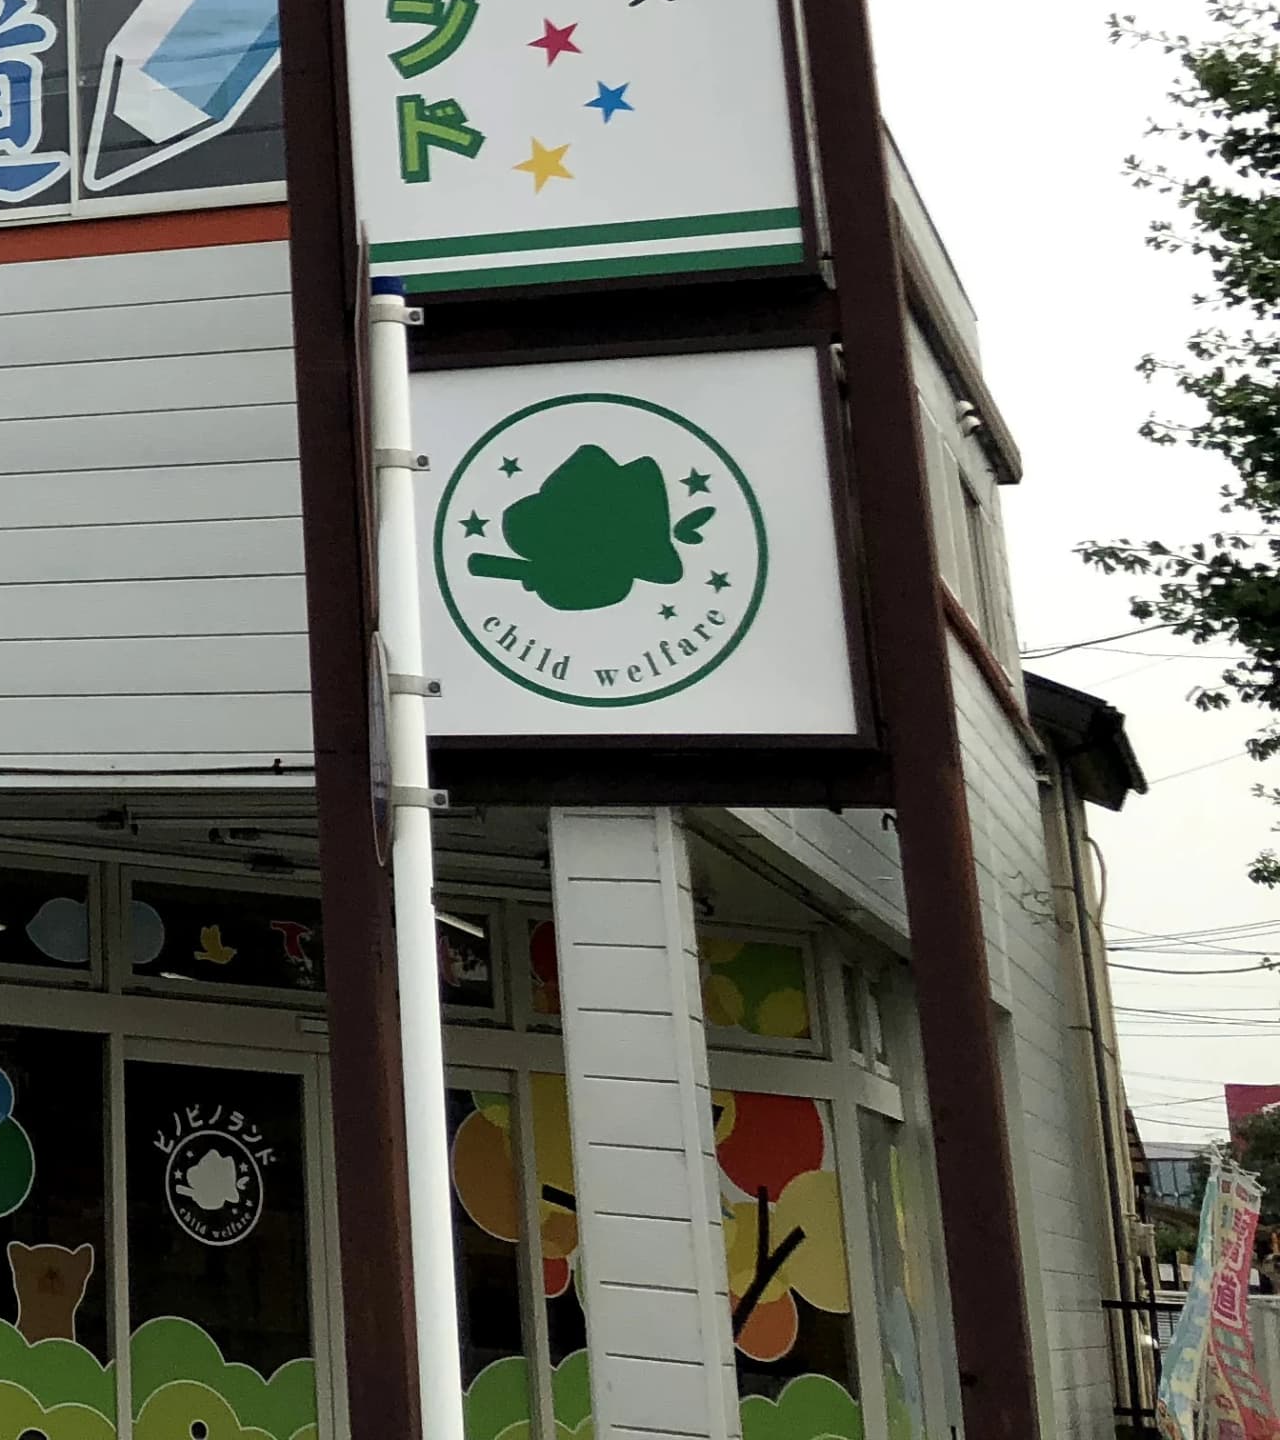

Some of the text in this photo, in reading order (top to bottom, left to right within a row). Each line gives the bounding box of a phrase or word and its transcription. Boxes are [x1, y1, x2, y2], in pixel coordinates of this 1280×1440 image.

[483, 607, 727, 687] child welfare
[179, 1207, 252, 1238] child welfare
